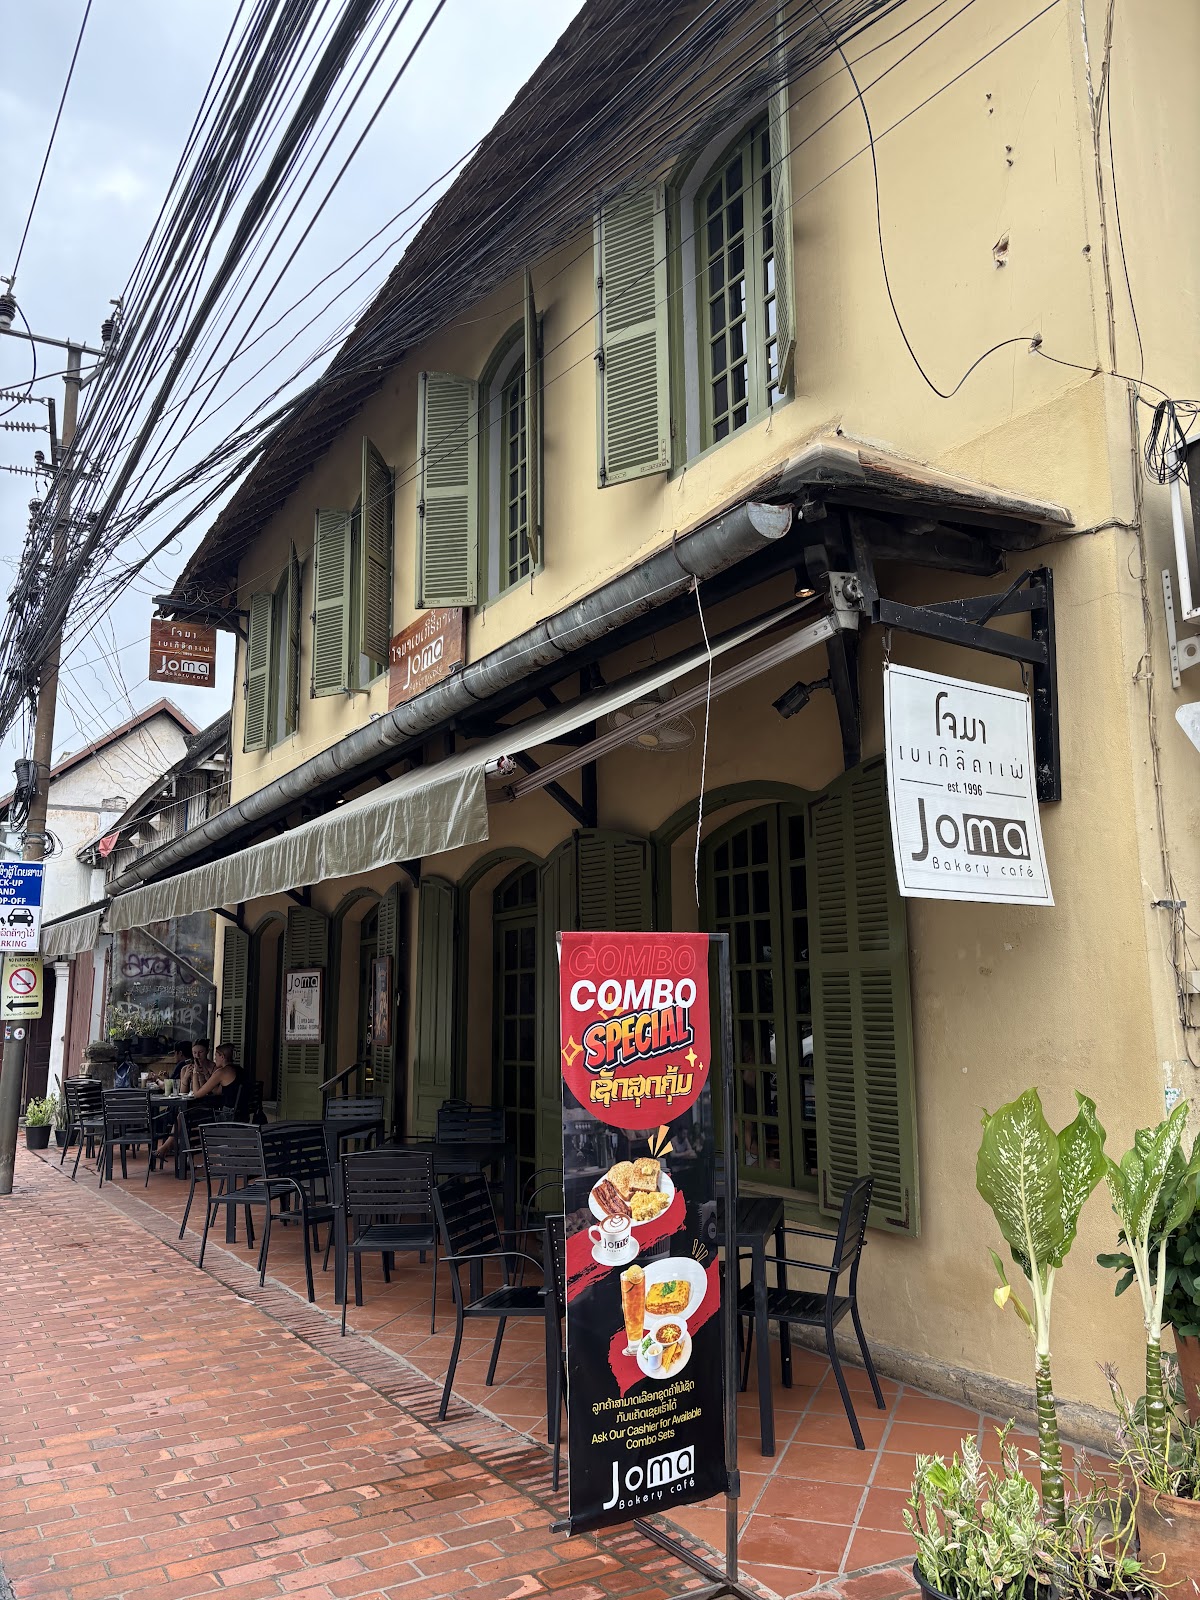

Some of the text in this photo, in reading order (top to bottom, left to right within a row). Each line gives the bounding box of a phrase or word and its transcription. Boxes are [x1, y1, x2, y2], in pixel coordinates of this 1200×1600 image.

[171, 626, 197, 639] ໂຈມາ
[157, 655, 209, 675] Joma
[403, 635, 443, 690] Joma
[935, 691, 987, 744] ໂຈມາ
[947, 781, 983, 796] est. 1996
[911, 797, 1031, 861] Joma
[932, 856, 1034, 878] Bakery café
[568, 944, 696, 978] COMBO
[289, 974, 318, 992] Joma
[569, 978, 697, 1012] COMBO
[584, 1005, 692, 1068] SPECIAL
[591, 1406, 702, 1445] Ask Our Cashier for Available
[625, 1428, 676, 1450] Combo Sets
[602, 1444, 695, 1511] Joma
[618, 1477, 696, 1510] Bakery café
